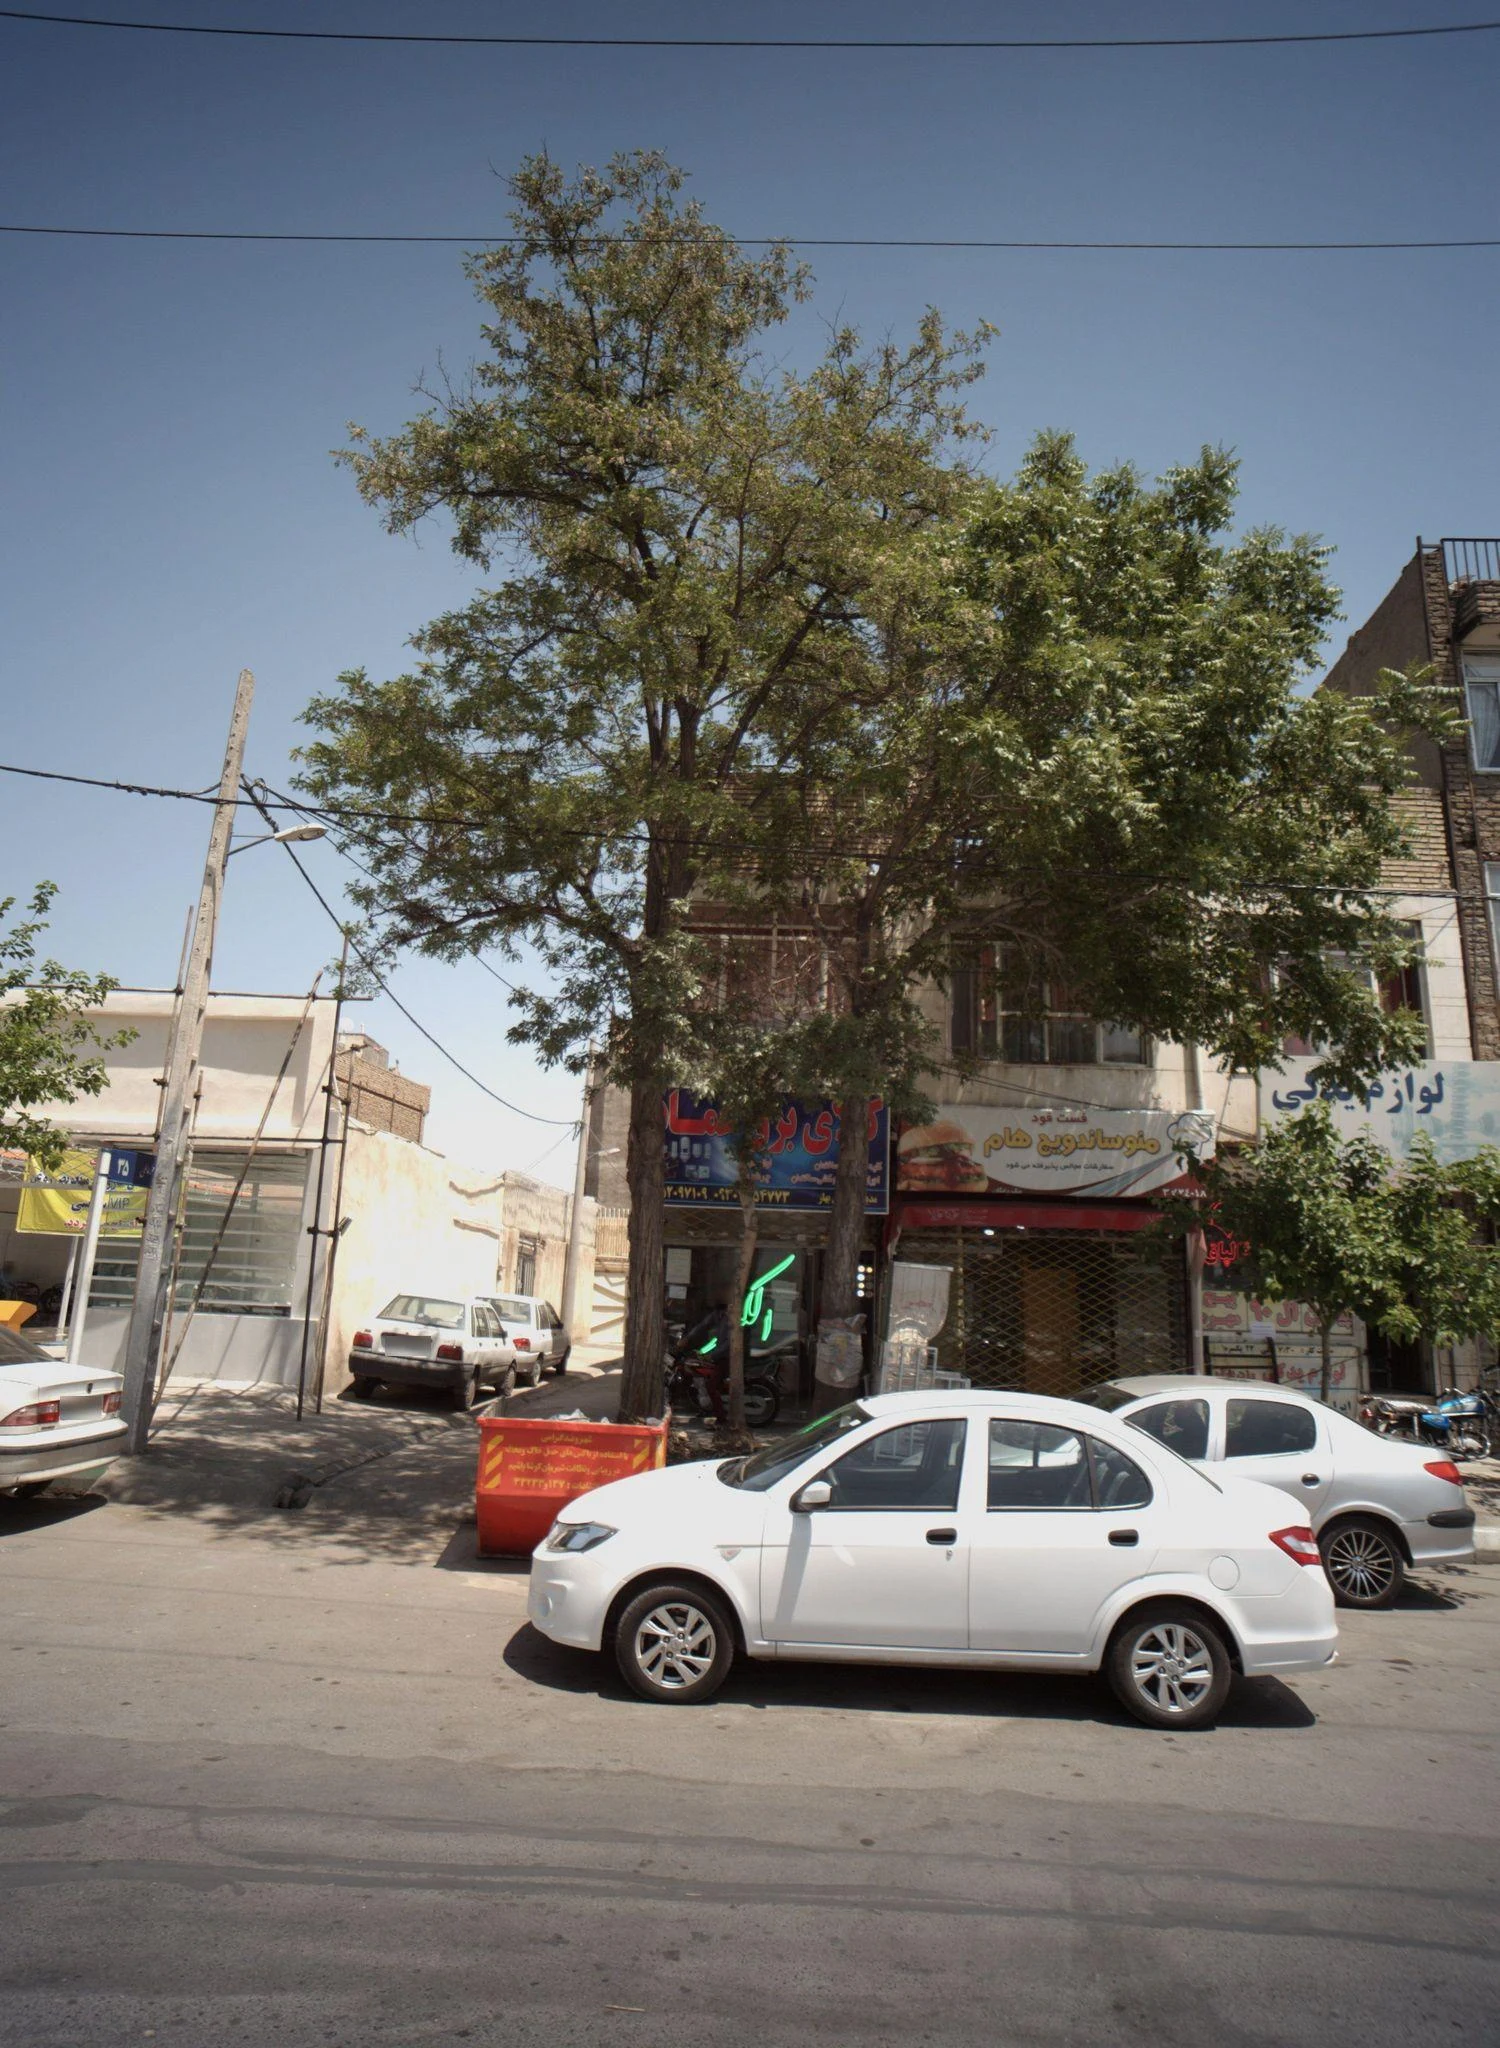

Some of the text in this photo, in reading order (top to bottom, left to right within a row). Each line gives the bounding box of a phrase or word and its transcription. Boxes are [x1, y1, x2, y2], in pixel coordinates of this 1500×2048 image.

[1364, 1072, 1444, 1114] لوازم
[1032, 1113, 1088, 1125] فست فود
[984, 1126, 1033, 1158] هام
[117, 1158, 130, 1177] ۳۵
[1006, 1161, 1020, 1171] شود
[110, 1197, 130, 1209] VIP
